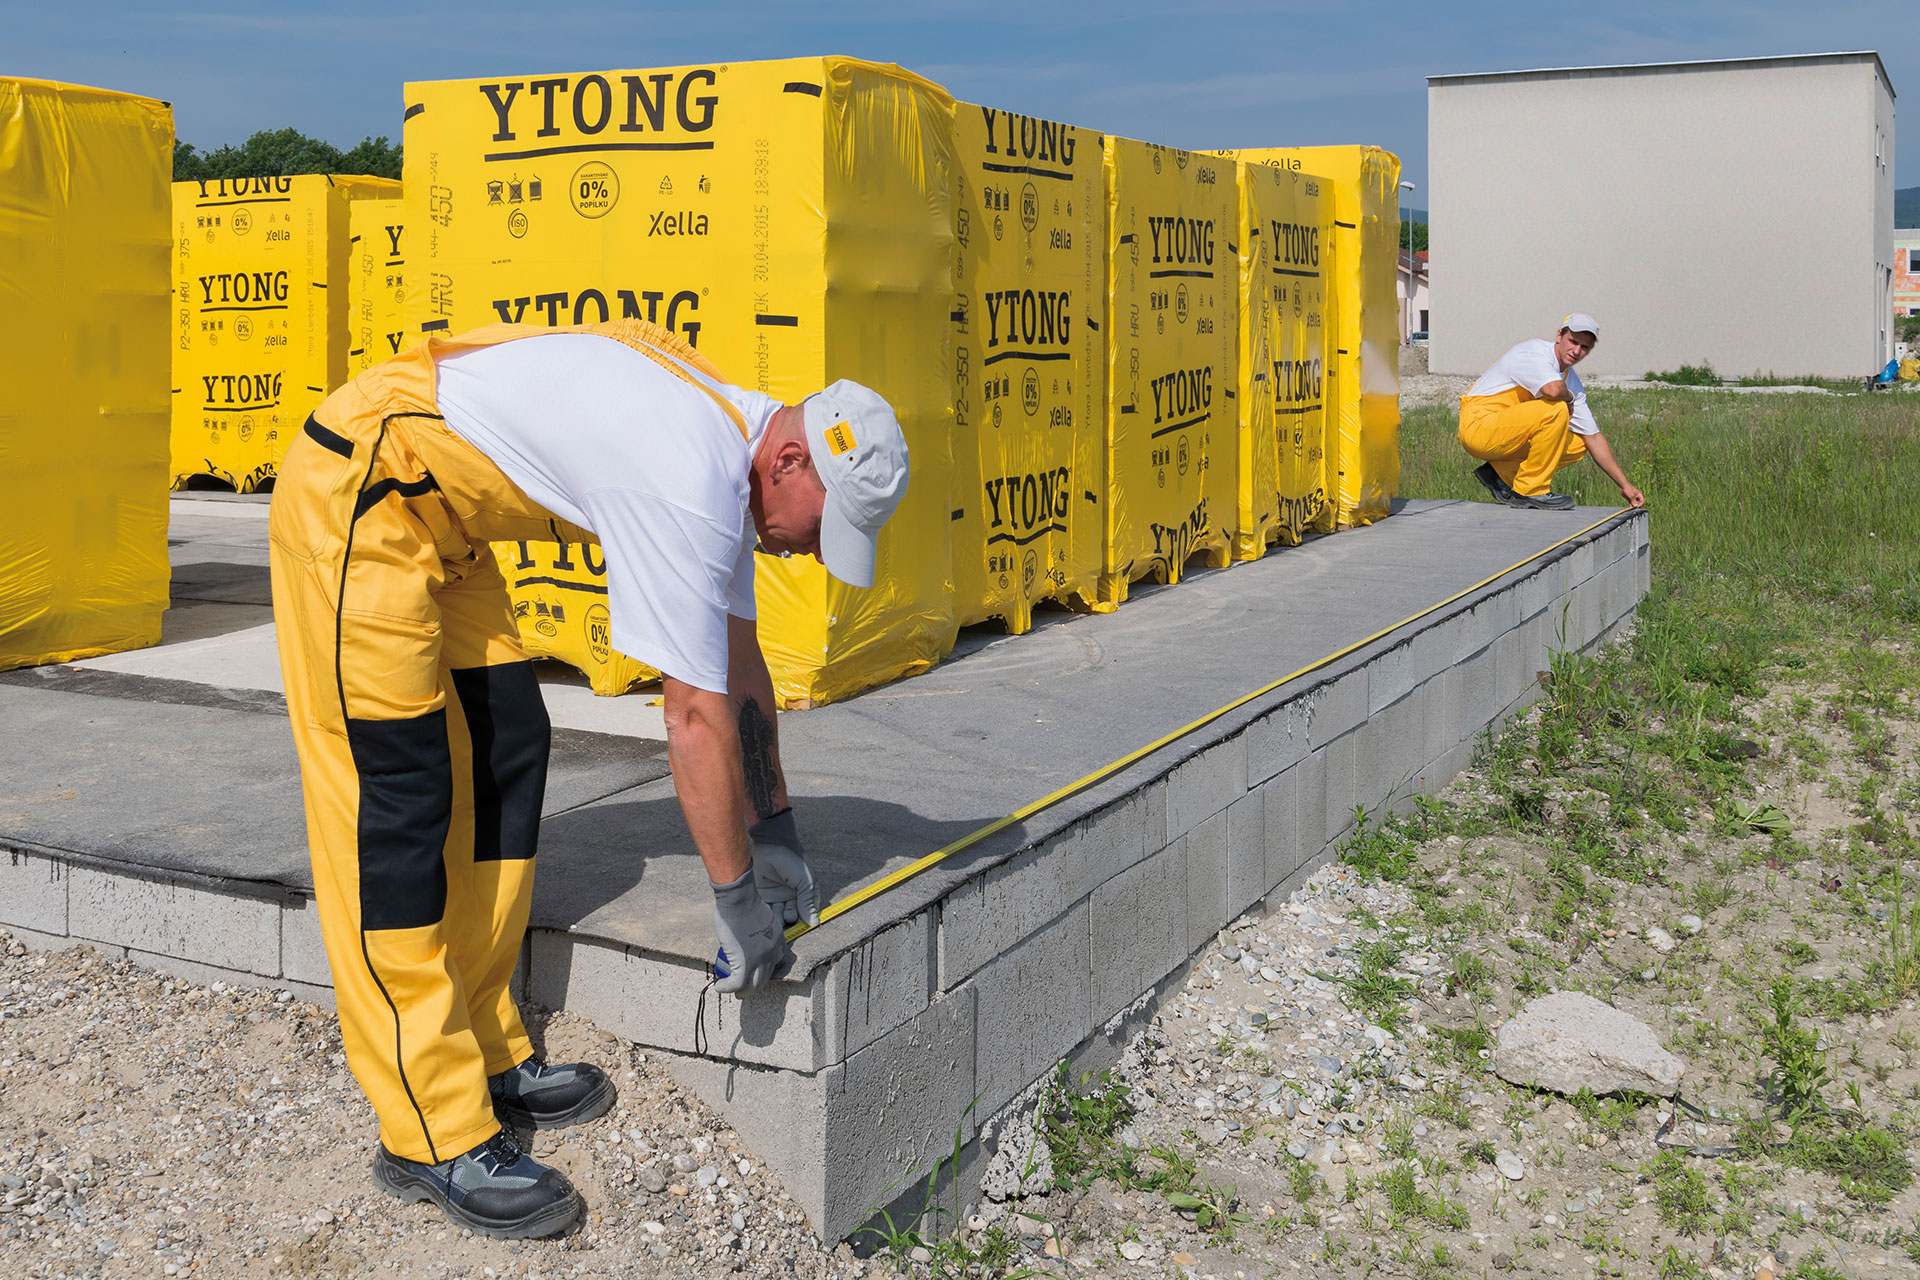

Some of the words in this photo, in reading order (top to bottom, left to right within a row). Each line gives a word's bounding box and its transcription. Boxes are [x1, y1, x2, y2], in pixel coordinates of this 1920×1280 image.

[480, 70, 719, 142] YTONG
[981, 106, 1075, 166] YTONG
[754, 139, 769, 196] 18:39:18
[580, 181, 608, 199] 0%
[580, 200, 608, 209] POPÍLKU
[235, 218, 248, 226] 0%
[1024, 200, 1035, 215] 0%
[266, 230, 290, 242] Xella
[648, 211, 708, 237] Xella
[1050, 228, 1072, 249] Xella
[754, 204, 769, 282] 30.04.2015
[1149, 216, 1214, 266] YTONG
[1272, 219, 1319, 267] YTONG
[180, 281, 190, 303] HRU
[199, 271, 288, 304] YTONG
[431, 272, 453, 317] HRU
[180, 308, 190, 350] P2-350
[238, 325, 249, 333] 0%
[985, 289, 1070, 348] YTONG
[1130, 303, 1140, 338] HRU
[1197, 317, 1214, 335] Xella
[265, 335, 287, 347] Xella
[202, 372, 282, 403] YTONG
[957, 346, 969, 426] P2-350
[1026, 384, 1037, 399] 0%
[1151, 366, 1212, 424] YTONG
[1274, 358, 1321, 402] YTONG
[1050, 406, 1071, 429] Xella
[832, 425, 848, 452] YTONG
[986, 466, 1069, 530] YTONG
[591, 624, 608, 646] 0%
